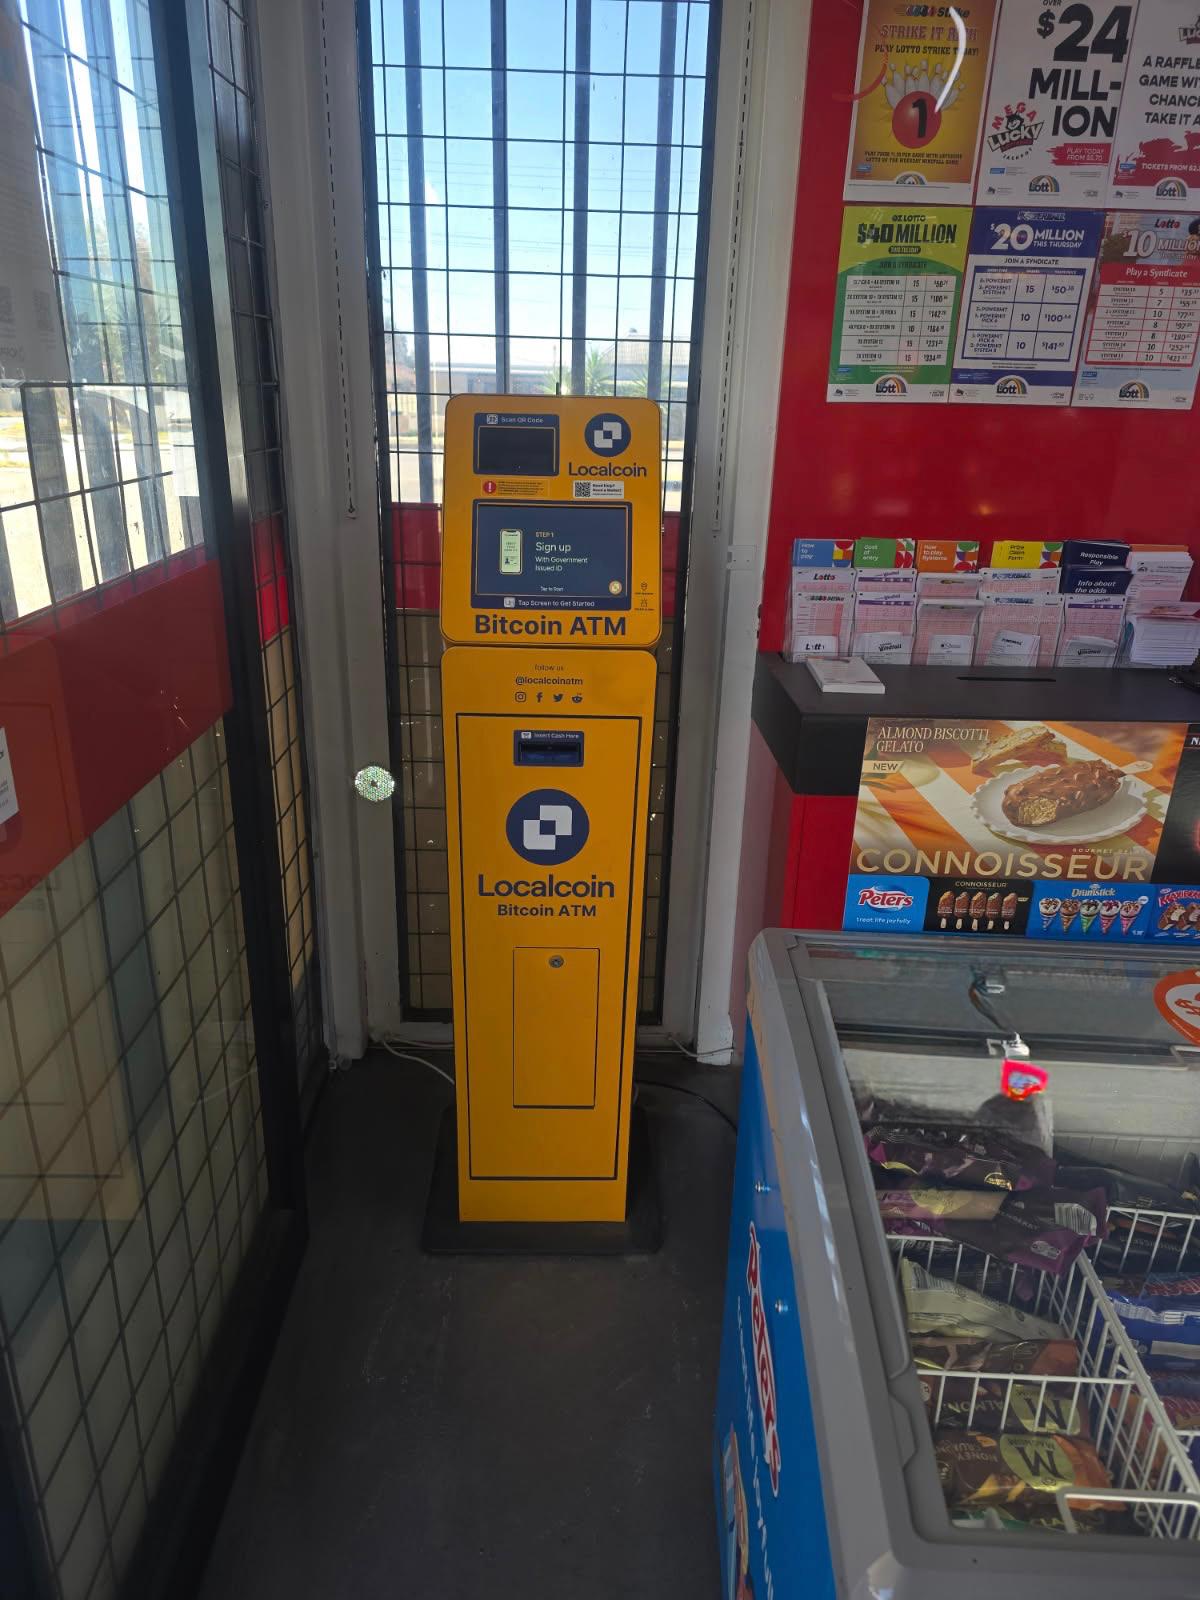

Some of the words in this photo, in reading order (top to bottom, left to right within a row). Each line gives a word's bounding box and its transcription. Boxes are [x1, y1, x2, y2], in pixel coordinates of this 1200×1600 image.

[880, 25, 928, 39] STRIKE
[1037, 4, 1132, 63] $24
[896, 45, 920, 54] LOTTO
[922, 46, 951, 55] STRIKE
[953, 47, 979, 56] TDAY!
[1142, 55, 1153, 67] A
[1028, 67, 1122, 101] MILL-
[1139, 74, 1179, 88] GAME
[911, 98, 926, 138] 1
[992, 102, 1037, 130] MEGA
[1052, 105, 1118, 137] ION
[1144, 112, 1177, 125] TAKE
[1180, 113, 1191, 125] IT
[1154, 219, 1180, 229] Lotto
[895, 223, 957, 244] MILLION
[990, 223, 1034, 251] $20
[1034, 229, 1085, 241] MILLION
[1033, 240, 1048, 248] THIS
[1126, 267, 1142, 278] Play
[1149, 268, 1188, 279] Syndicate
[1025, 285, 1035, 293] 15
[1021, 313, 1031, 321] 10
[1153, 310, 1163, 318] 10
[501, 416, 516, 424] Scan
[517, 416, 526, 424] QR
[568, 462, 647, 477] Localcoin
[535, 541, 557, 553] Sign
[559, 544, 571, 553] up
[1080, 551, 1119, 560] Responsible
[475, 613, 562, 635] Bitcoin
[570, 616, 626, 636] ATM
[515, 676, 583, 685] @localcoinatm
[878, 726, 932, 740] ALMOND
[933, 727, 990, 741] BISCOTTI
[876, 740, 924, 753] GELATO
[872, 763, 898, 771] NEW
[856, 849, 1149, 880] CONNOISSEUR
[478, 873, 615, 898] Localcoin
[1071, 887, 1116, 897] Drumstick
[858, 888, 914, 907] Peters
[497, 904, 554, 916] Bitcoin
[558, 905, 597, 917] ATM
[746, 1220, 781, 1497] Peters
